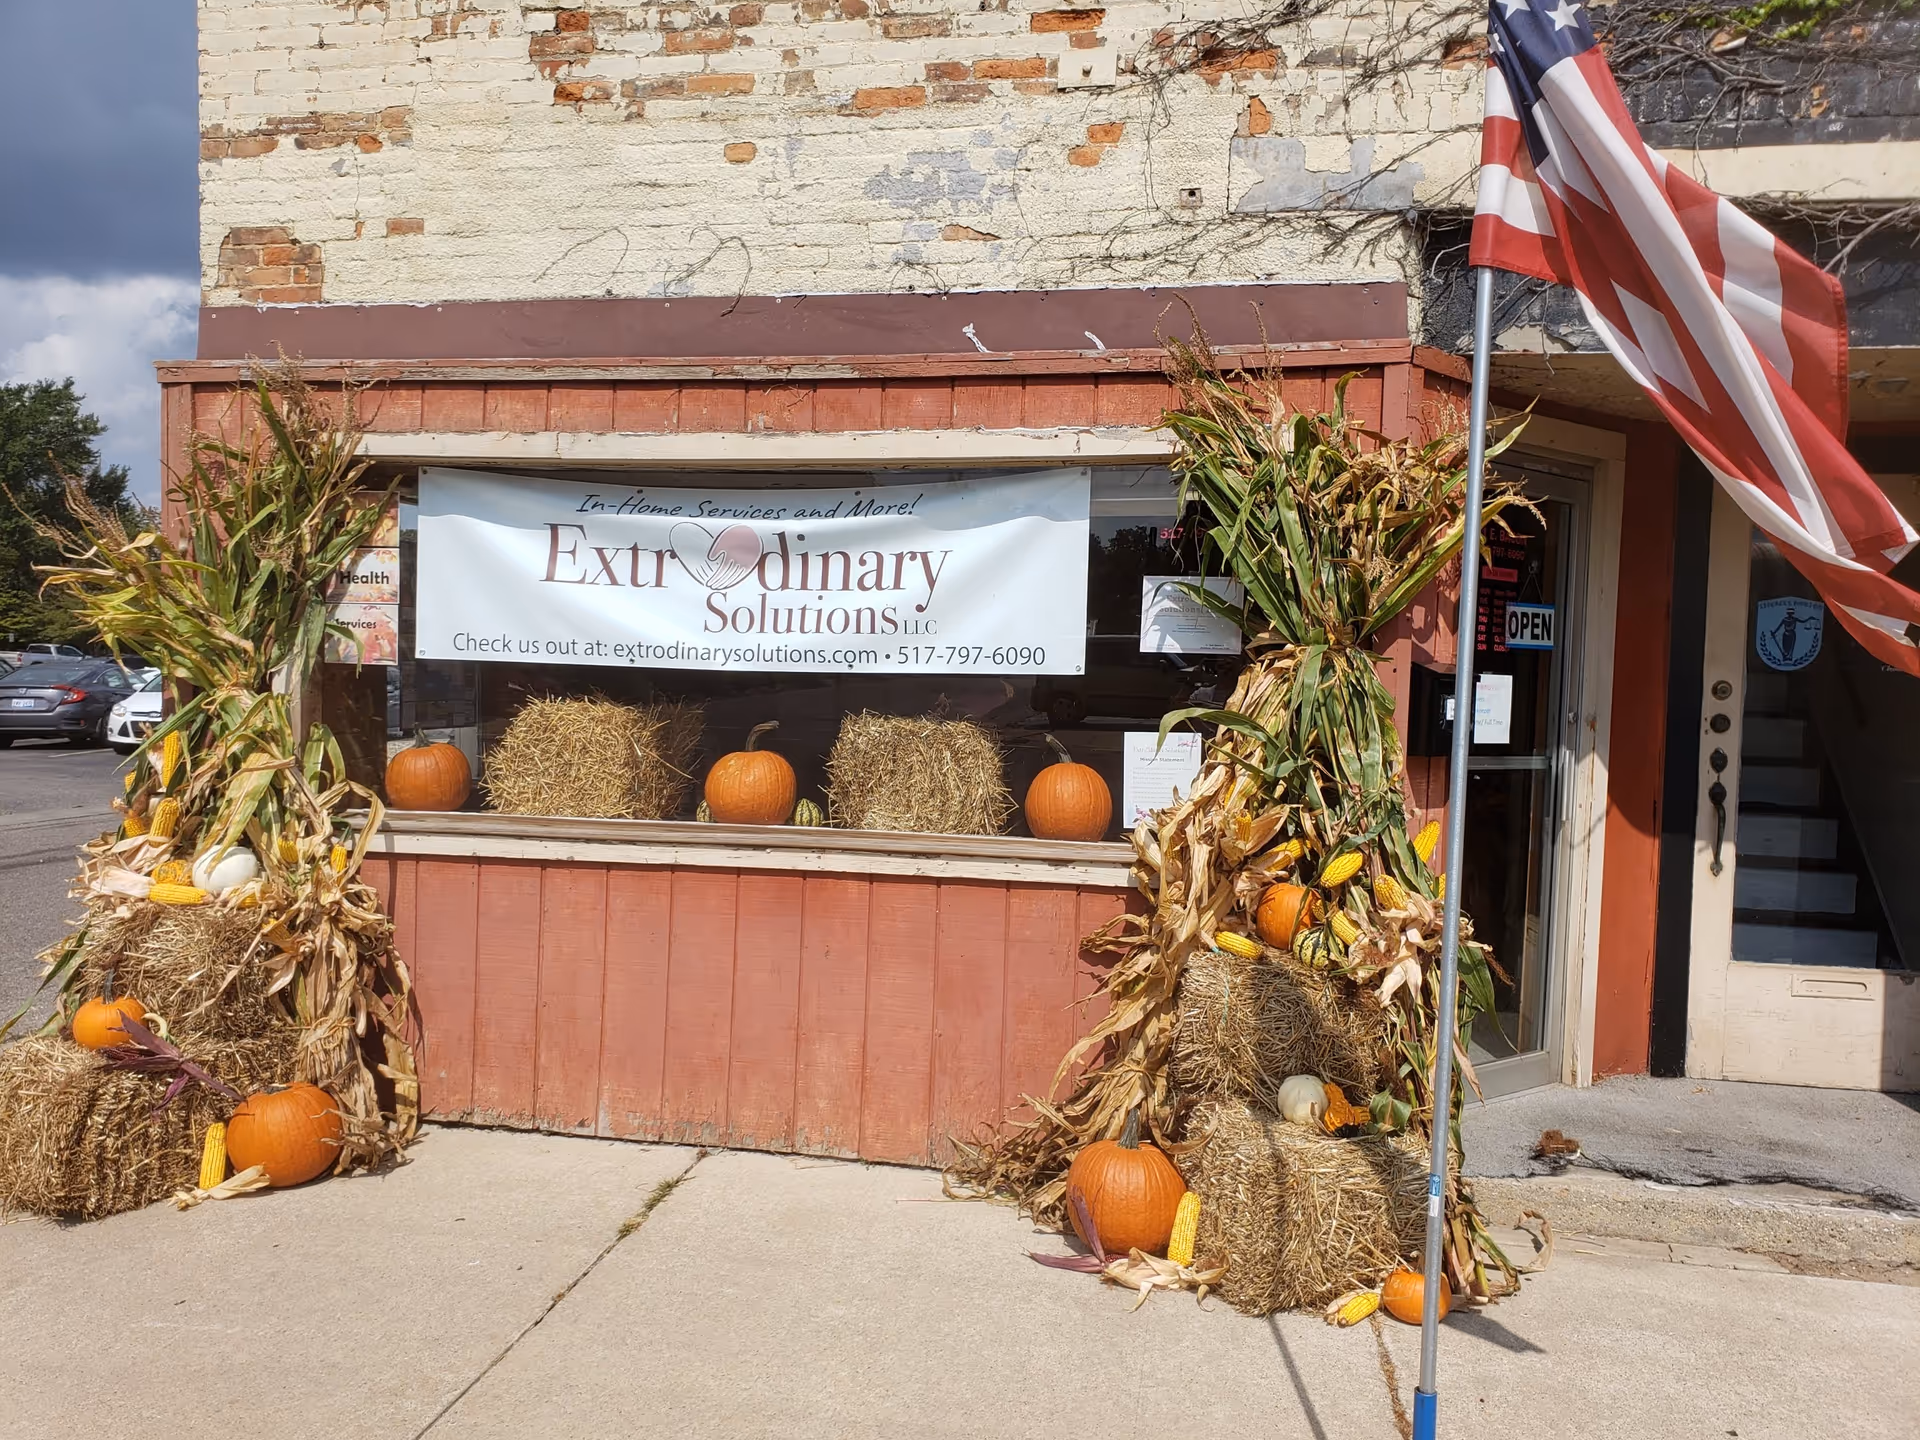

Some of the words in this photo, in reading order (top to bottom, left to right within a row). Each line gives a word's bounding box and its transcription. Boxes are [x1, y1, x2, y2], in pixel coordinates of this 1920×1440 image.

[575, 494, 683, 516] In-Home
[689, 499, 787, 519] Services
[793, 500, 844, 518] and
[844, 493, 924, 519] More!
[339, 570, 390, 586] Health
[703, 592, 899, 635] Solutions
[903, 619, 938, 635] LLC
[1508, 610, 1552, 641] OPEN
[453, 632, 512, 653] Check
[519, 639, 540, 654] us
[545, 638, 579, 656] out
[584, 639, 608, 657] at:
[614, 640, 879, 666] extrodinarysolutions.com
[897, 646, 1046, 666] 517-797-6090
